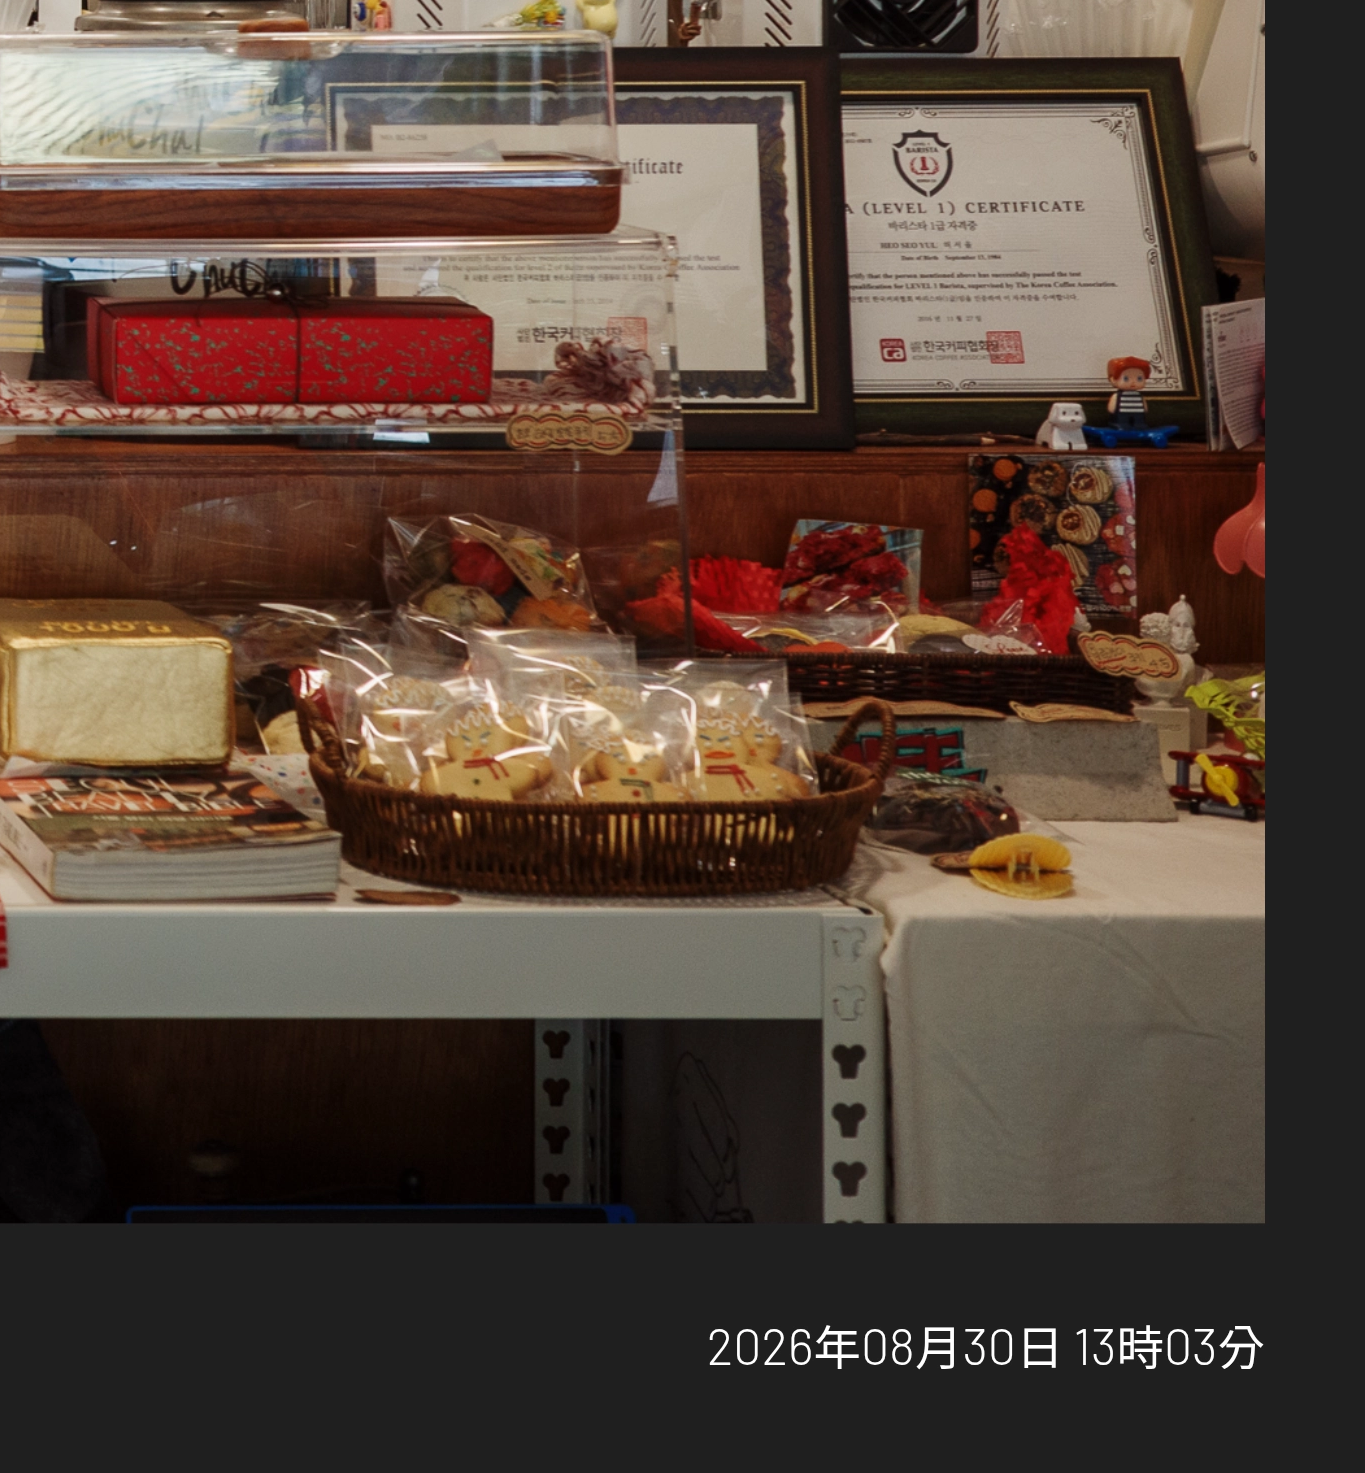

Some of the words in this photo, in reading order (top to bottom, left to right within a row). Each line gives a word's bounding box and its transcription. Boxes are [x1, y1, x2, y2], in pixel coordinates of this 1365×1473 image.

[862, 201, 928, 216] (LEVEL
[938, 200, 957, 216] 1)
[965, 199, 1087, 215] CERTIFICATE
[887, 220, 928, 233] 바리스타
